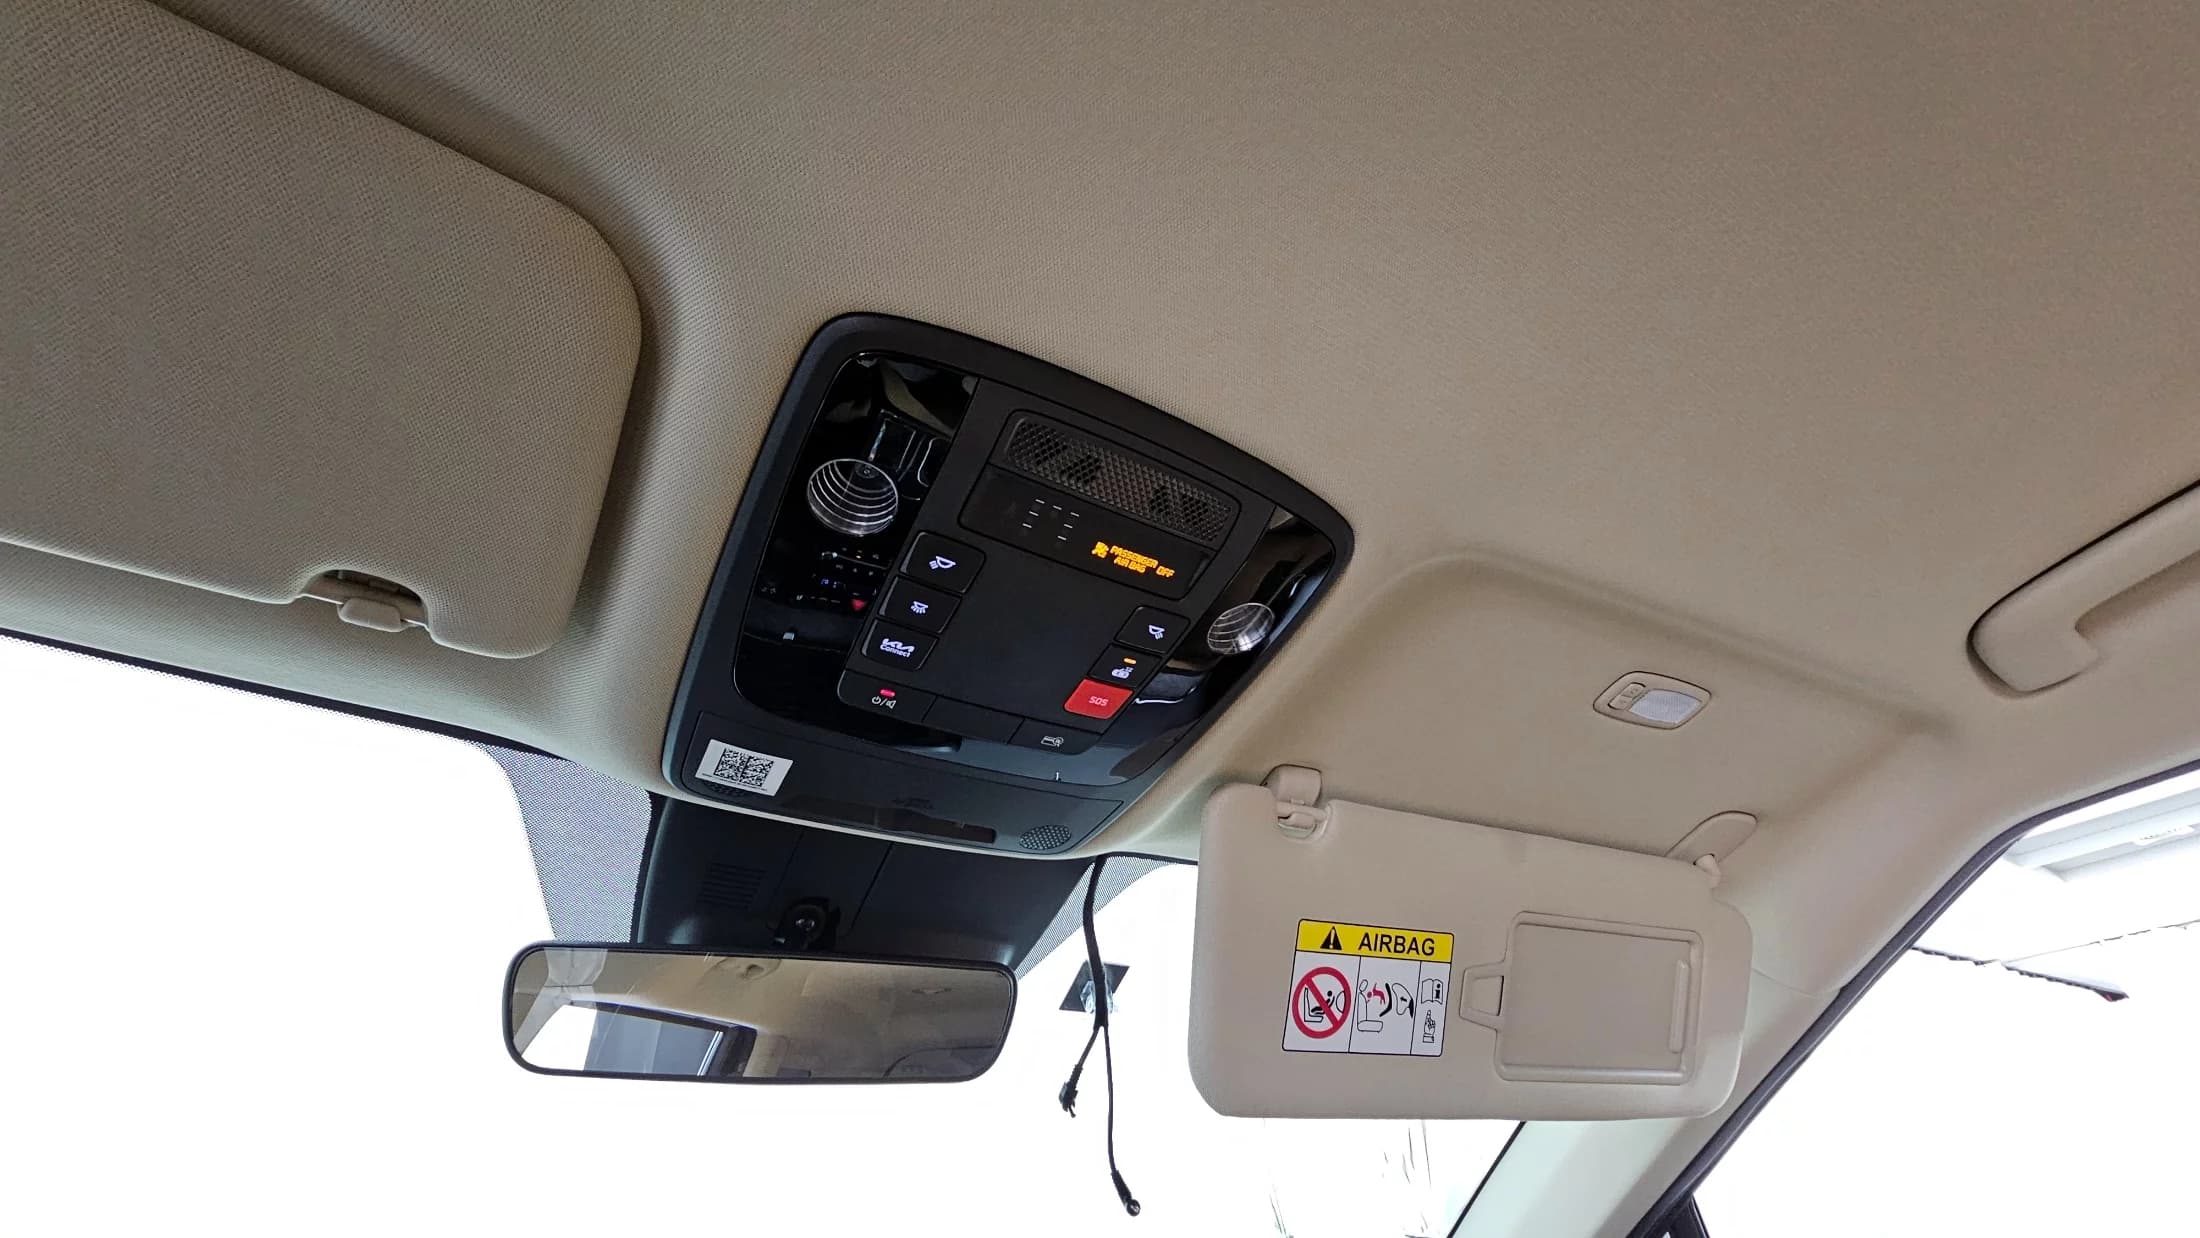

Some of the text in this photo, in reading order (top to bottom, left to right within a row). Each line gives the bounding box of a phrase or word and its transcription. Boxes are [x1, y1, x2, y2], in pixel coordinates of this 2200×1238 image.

[1110, 545, 1158, 568] PASSENGER
[1156, 566, 1175, 577] OFF
[880, 644, 911, 657] Connect
[1088, 695, 1109, 706] SOS
[1358, 932, 1435, 956] AIRBAG
